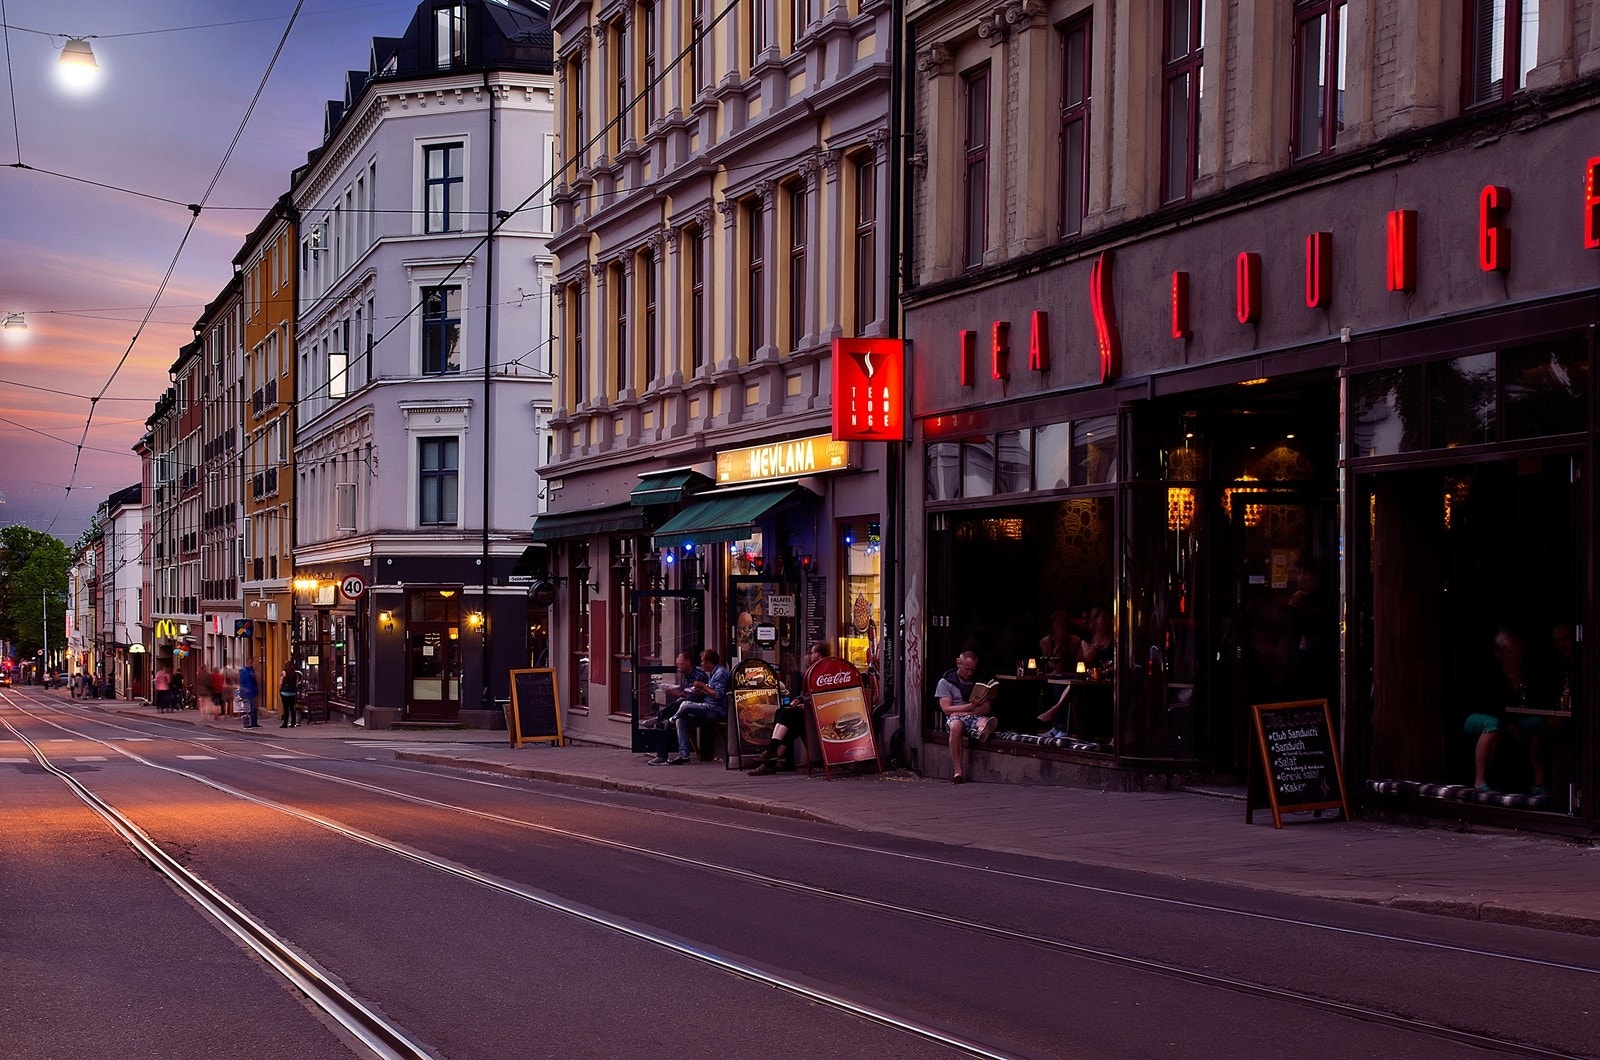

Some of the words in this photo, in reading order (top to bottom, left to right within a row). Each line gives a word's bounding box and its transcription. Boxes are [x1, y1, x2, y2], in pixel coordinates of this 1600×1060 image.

[959, 310, 1050, 387] TEA
[1172, 156, 1600, 340] LOUNGE
[851, 386, 890, 398] TEA
[749, 440, 815, 478] MEVLANA
[345, 581, 362, 593] 40
[1272, 731, 1287, 741] Club
[1287, 728, 1319, 739] Sandwich
[1274, 740, 1306, 752] Sandwich
[1277, 756, 1297, 767] Salat
[1280, 771, 1302, 781] Gresk
